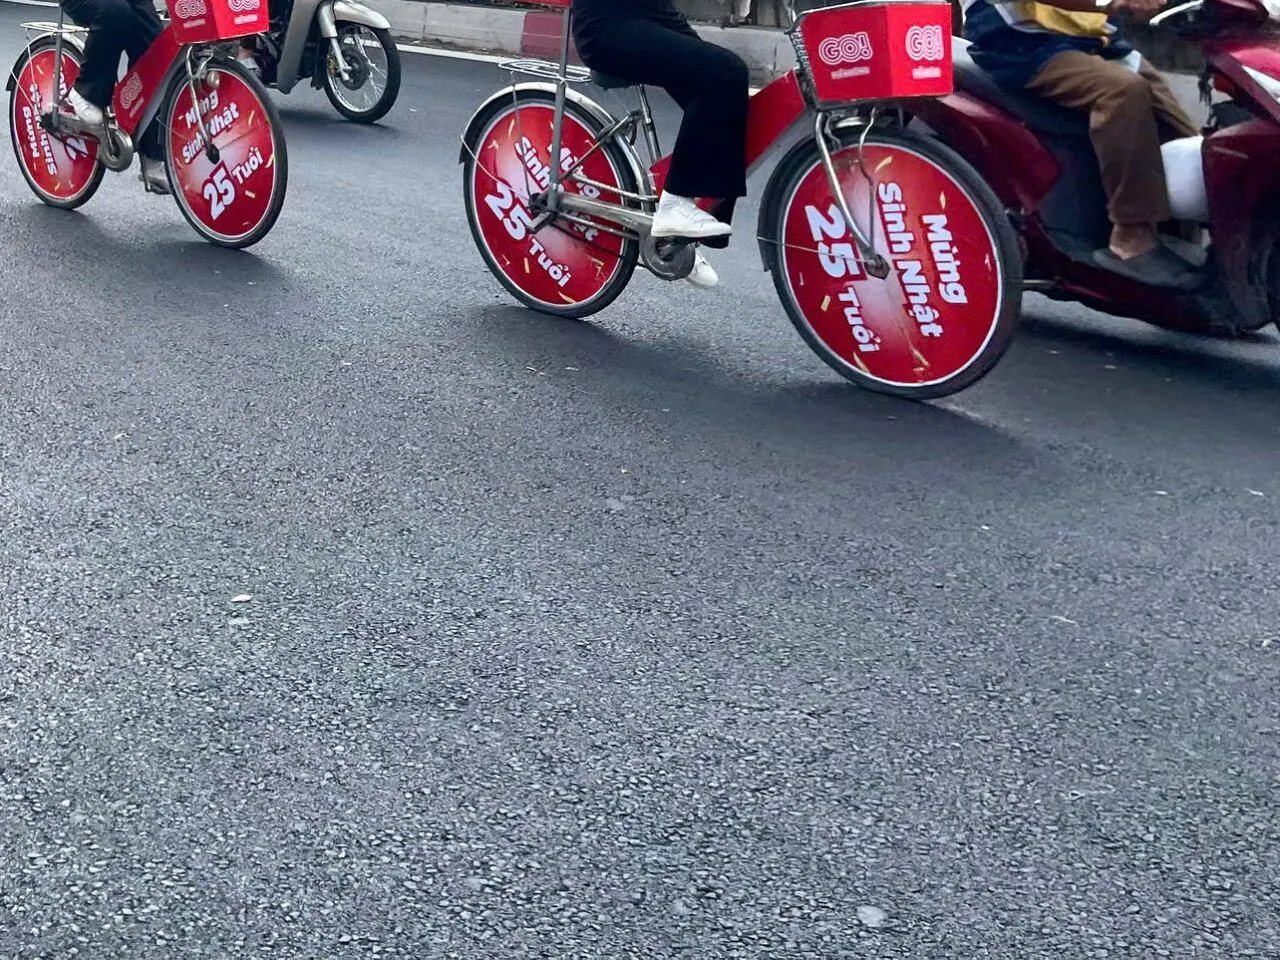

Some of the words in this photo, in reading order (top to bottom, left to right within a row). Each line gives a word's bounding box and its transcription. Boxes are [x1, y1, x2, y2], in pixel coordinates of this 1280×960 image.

[819, 32, 873, 65] GO!
[906, 26, 944, 61] GO!
[203, 169, 236, 221] 25
[231, 146, 264, 185] Tuổi
[878, 182, 915, 254] Sinh
[484, 181, 535, 241] 25
[528, 238, 572, 287] Tuổi
[922, 214, 968, 304] Mừng
[805, 203, 861, 278] 25
[838, 286, 881, 353] Tuổi
[896, 259, 944, 338] Nhật
